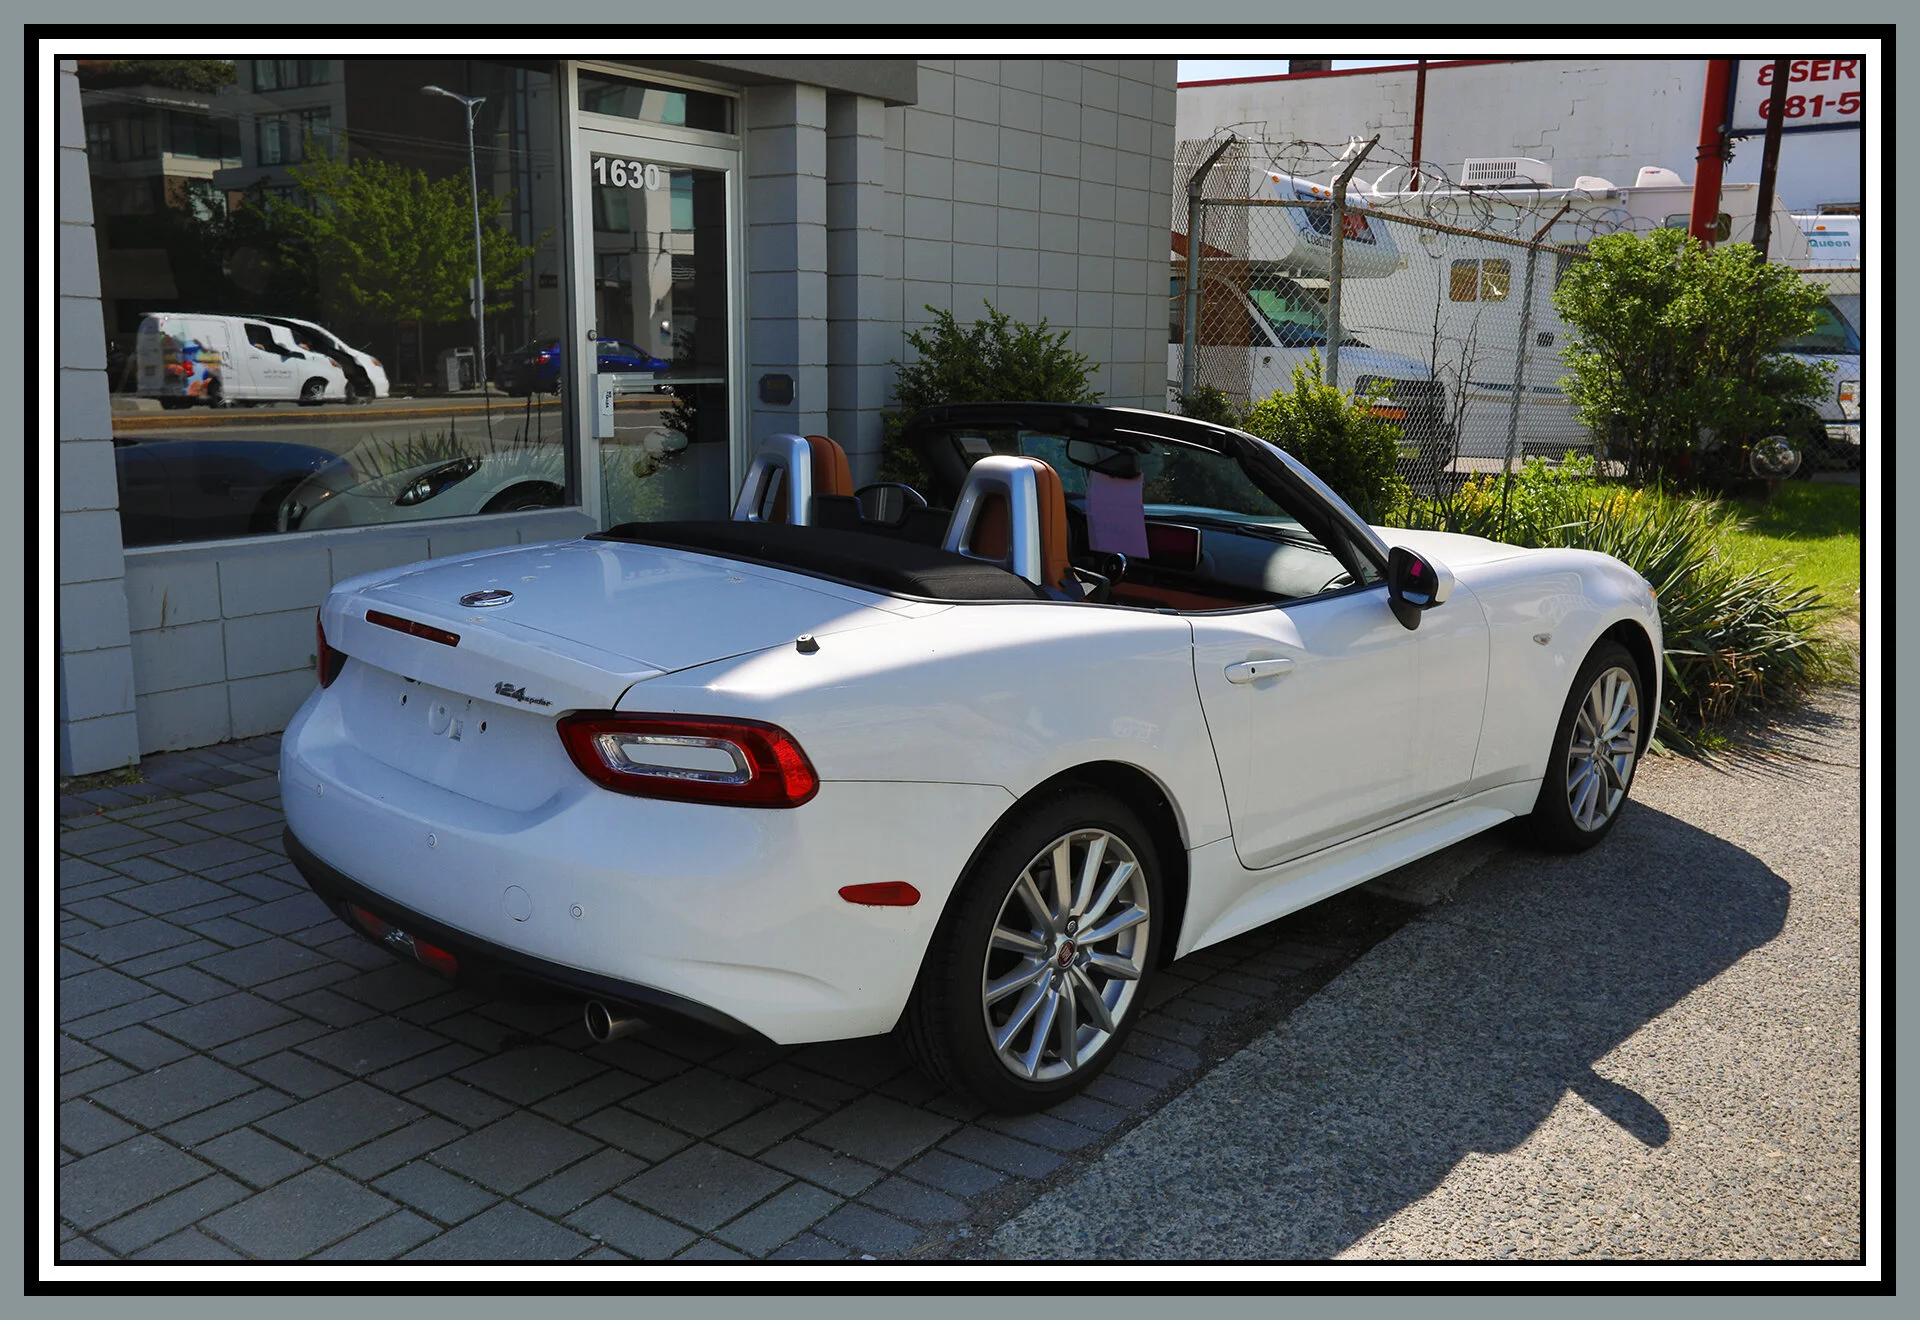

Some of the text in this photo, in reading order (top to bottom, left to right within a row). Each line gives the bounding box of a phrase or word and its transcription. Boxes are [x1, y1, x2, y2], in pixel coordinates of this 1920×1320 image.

[594, 157, 660, 190] 1630
[1808, 239, 1851, 248] Queen
[495, 681, 526, 702] 124
